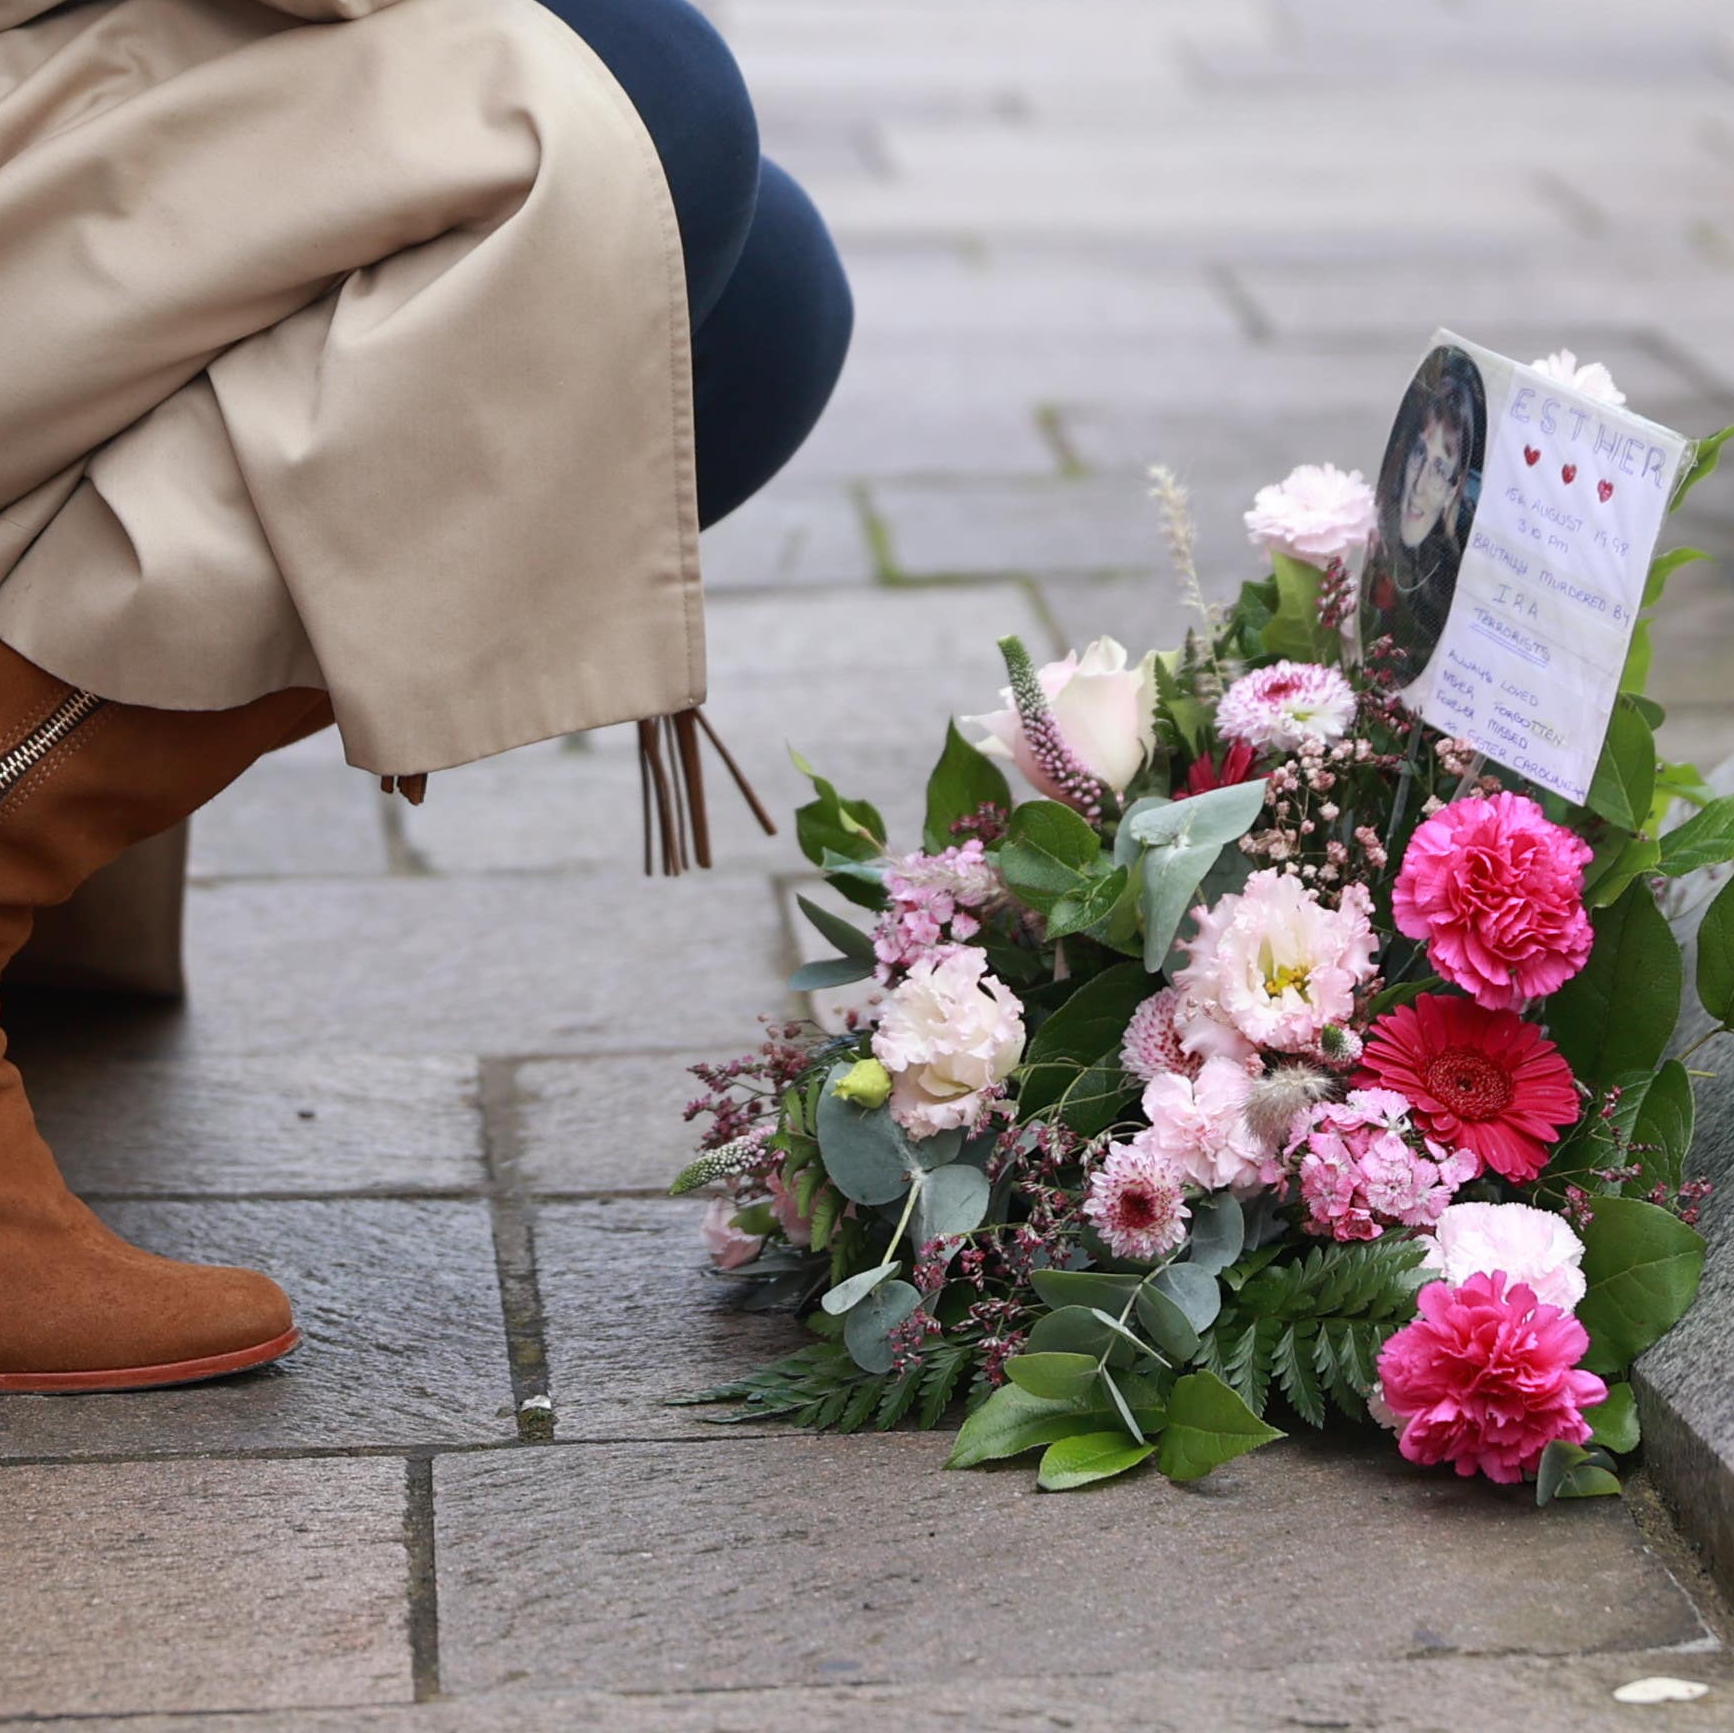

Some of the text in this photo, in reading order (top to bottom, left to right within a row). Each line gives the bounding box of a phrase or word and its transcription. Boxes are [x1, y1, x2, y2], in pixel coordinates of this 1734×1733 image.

[1510, 387, 1667, 489] ESTHER
[1531, 499, 1583, 532] AUGUST
[1472, 535, 1631, 628] BRUTALLY MURDERED BY
[1492, 583, 1538, 620] IRA
[1473, 607, 1551, 661] TERRORISTS
[1448, 649, 1539, 707] ALWAYS LOVED
[1487, 718, 1529, 750] MISSED
[1493, 700, 1564, 746] FORGOTTEN
